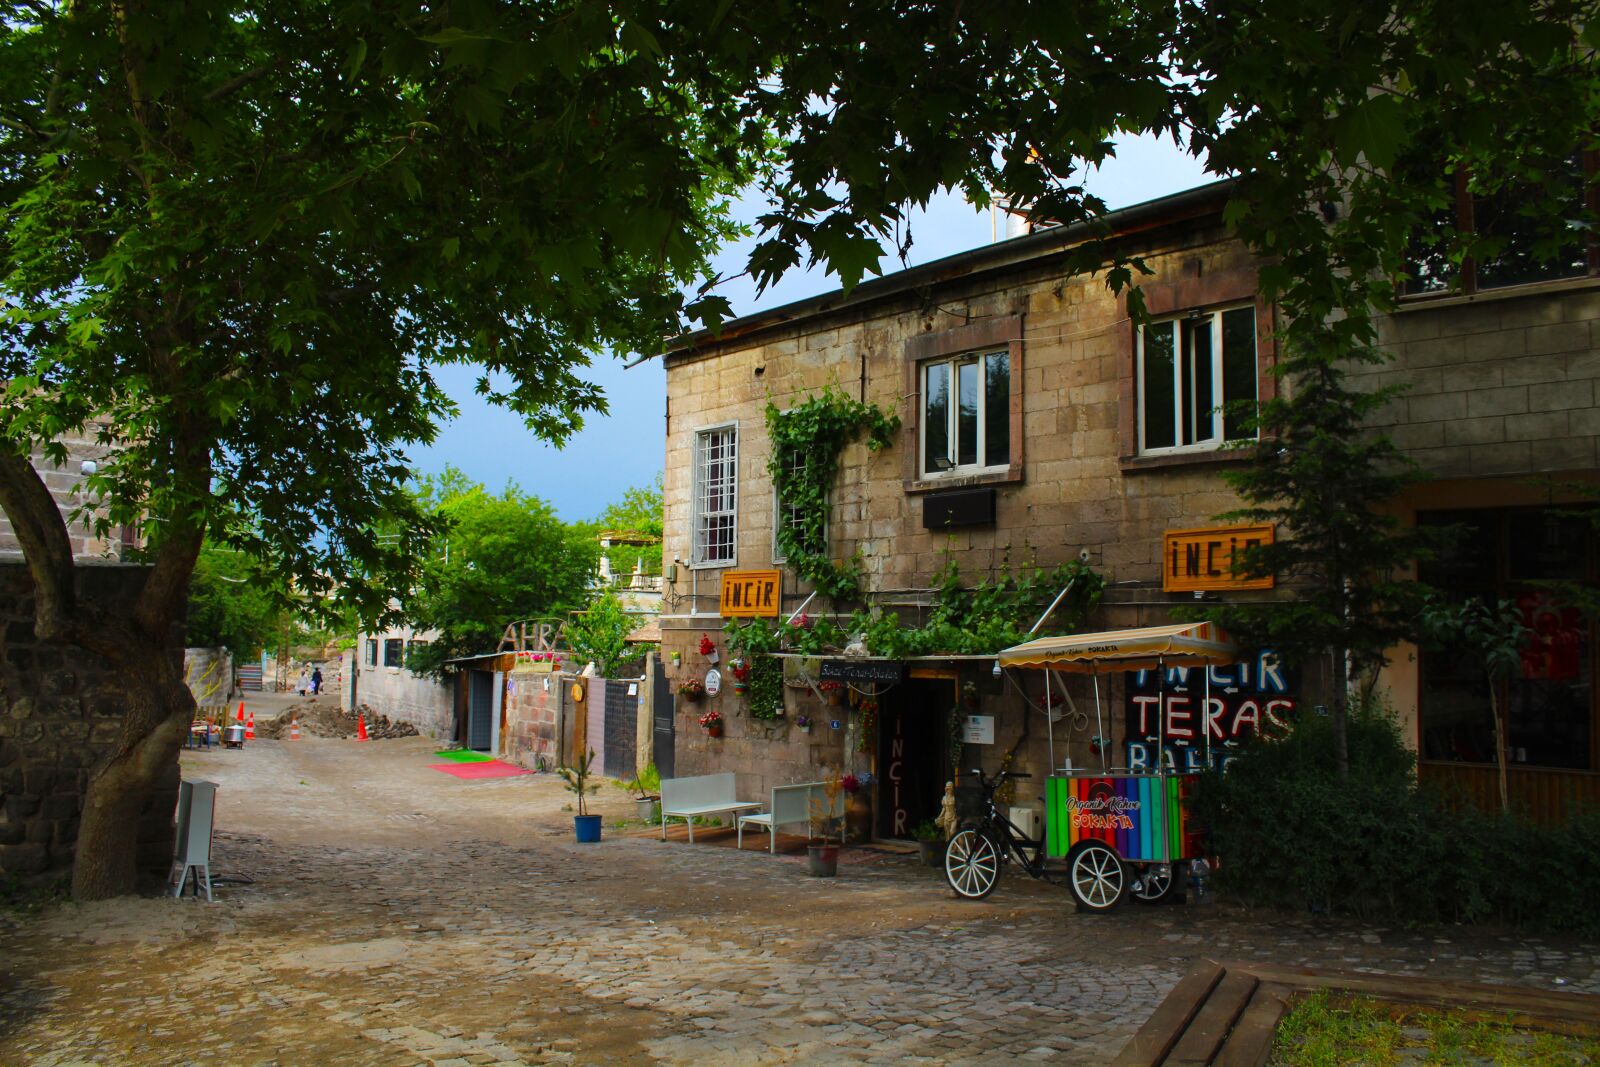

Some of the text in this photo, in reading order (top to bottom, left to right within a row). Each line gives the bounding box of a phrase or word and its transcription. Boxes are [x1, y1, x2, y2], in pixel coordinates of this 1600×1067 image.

[1130, 696, 1295, 743] TERAS
[1065, 796, 1141, 815] Organik Kahve
[1073, 814, 1134, 829] SOKAKTA
